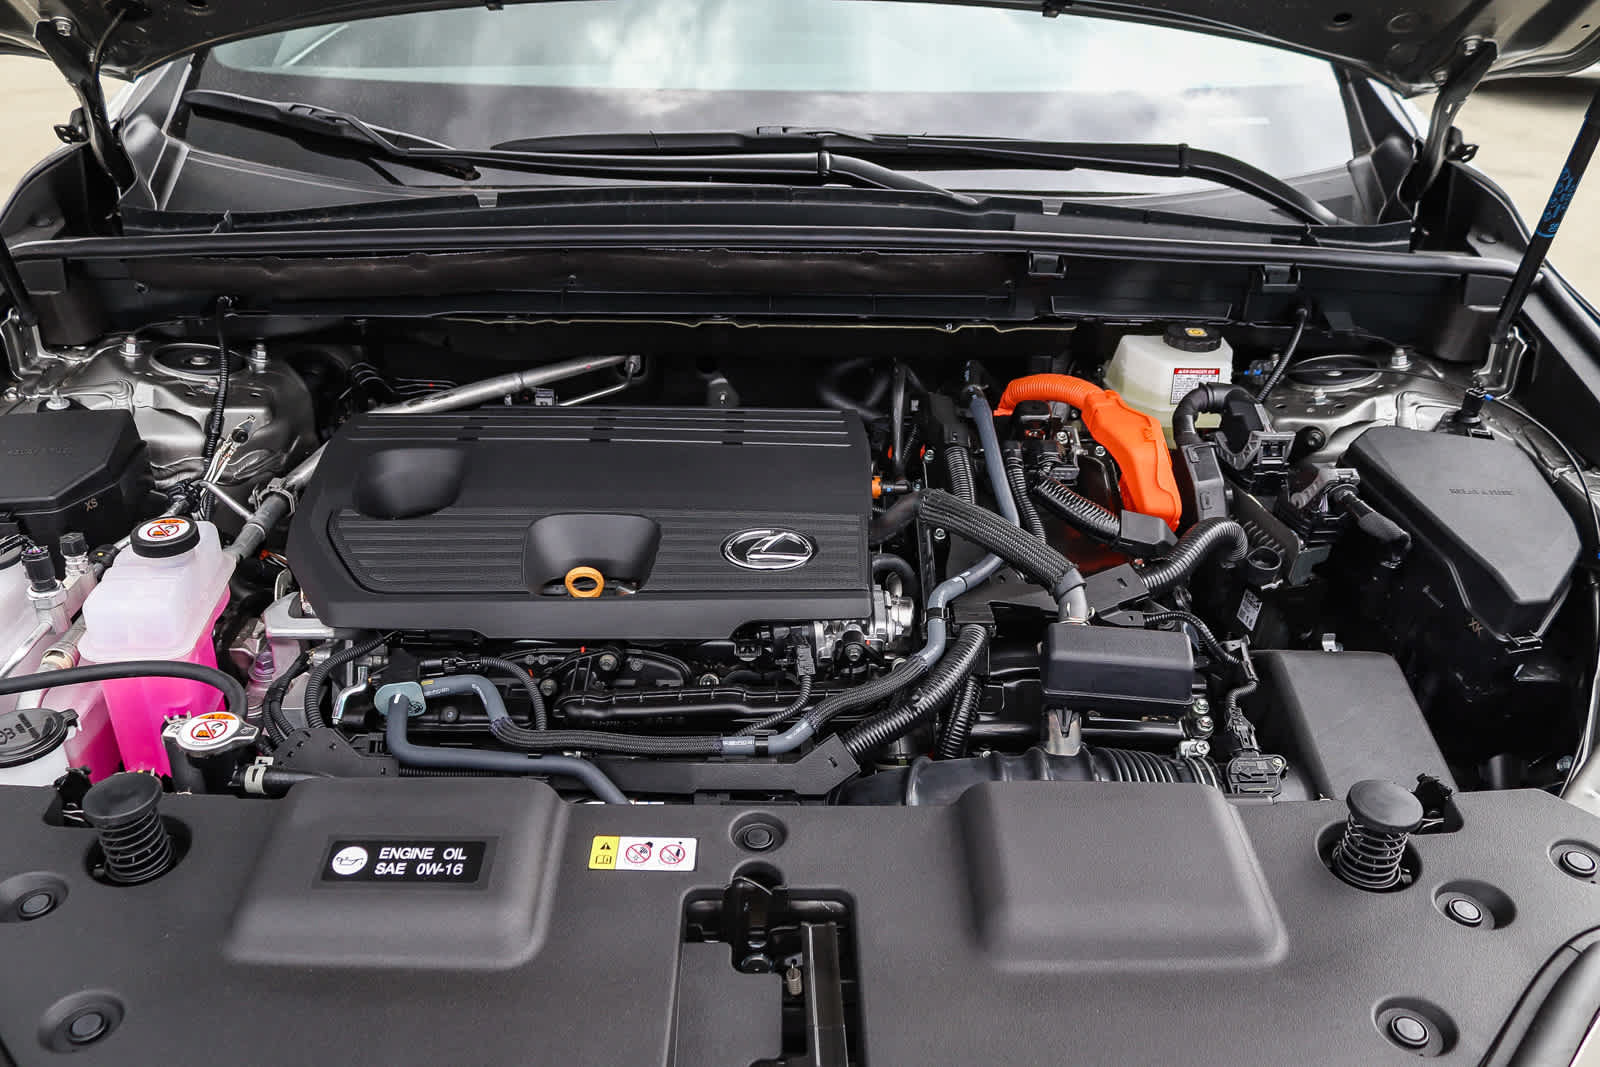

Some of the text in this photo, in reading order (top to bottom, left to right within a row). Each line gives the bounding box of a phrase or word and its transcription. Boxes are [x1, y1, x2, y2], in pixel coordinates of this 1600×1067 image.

[379, 847, 468, 860] ENGINE OIL
[374, 862, 464, 876] SAE 0W-16
